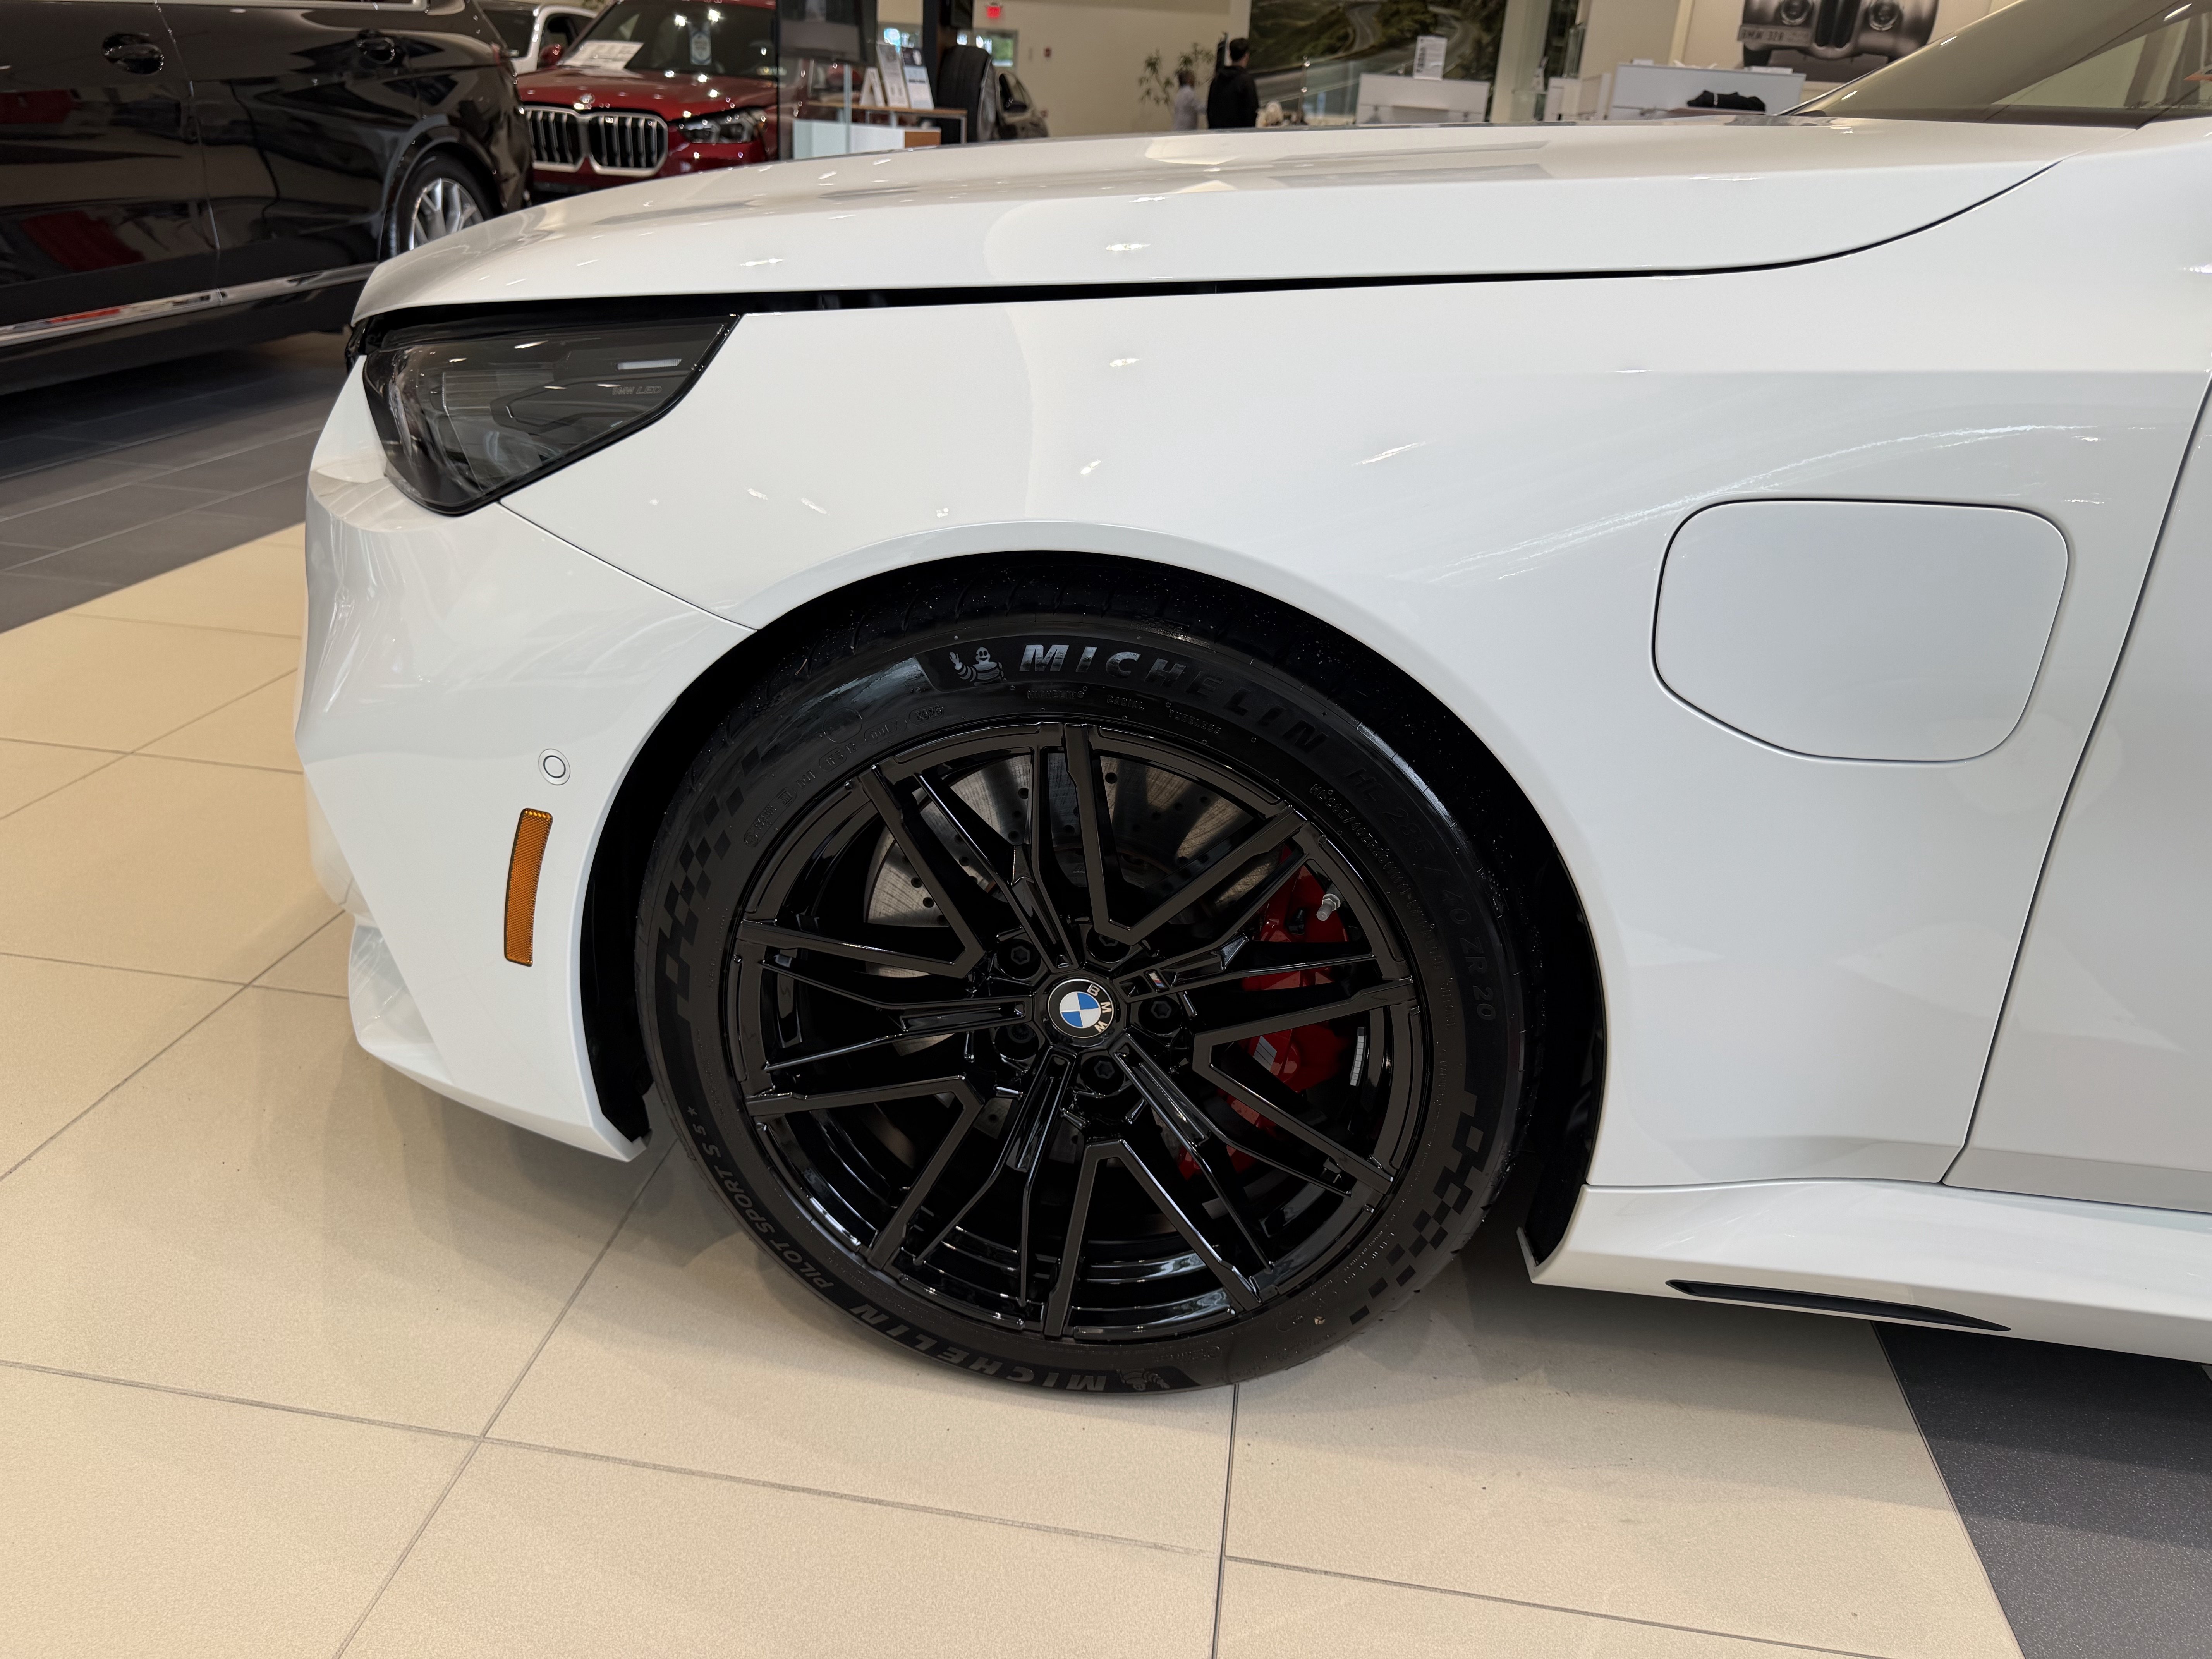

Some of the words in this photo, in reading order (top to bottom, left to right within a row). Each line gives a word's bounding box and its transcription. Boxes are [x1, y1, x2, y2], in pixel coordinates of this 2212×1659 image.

[635, 385, 662, 394] LED
[1020, 644, 1328, 754] MICHELIN
[1106, 695, 1146, 710] RADIAL
[1168, 709, 1223, 735] TUBELESS
[796, 770, 817, 788] DOT
[1341, 768, 1384, 802] HL
[1458, 938, 1489, 972] ZR
[1087, 984, 1112, 1032] BMW
[1472, 986, 1496, 1020] 20
[692, 1124, 706, 1134] 5
[701, 1142, 722, 1157] S
[714, 1165, 776, 1235] SPORT
[769, 1238, 835, 1288] PILOT
[849, 1303, 1108, 1391] MICHELIN
